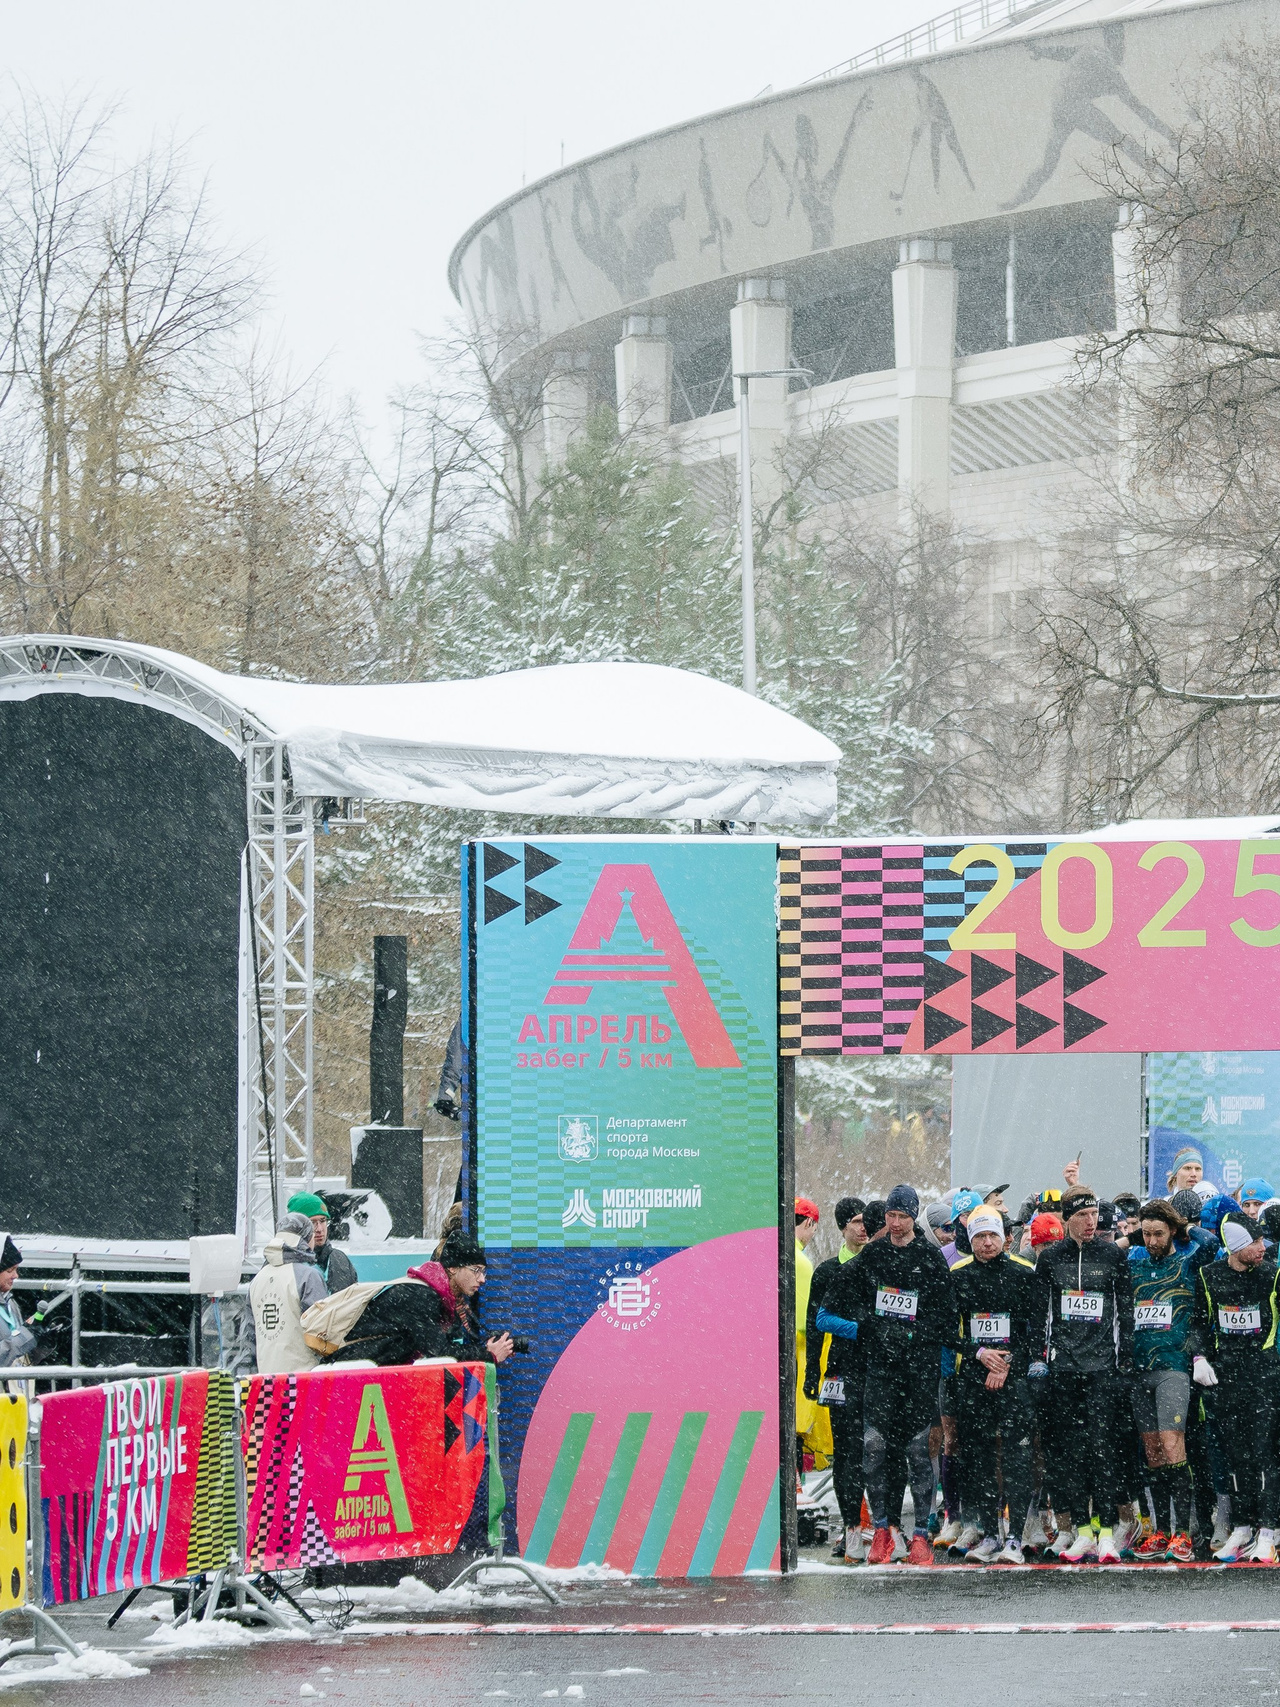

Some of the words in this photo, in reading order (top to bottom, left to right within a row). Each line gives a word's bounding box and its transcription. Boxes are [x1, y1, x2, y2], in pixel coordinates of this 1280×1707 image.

[517, 1014, 672, 1044] АПРЕЛЬ
[516, 1048, 590, 1068] забег
[618, 1048, 632, 1068] 5
[640, 1053, 672, 1068] км
[606, 1117, 687, 1130] Департамент
[607, 1133, 648, 1145] спорта
[607, 1148, 648, 1160] города
[653, 1147, 700, 1157] Москвы
[602, 1185, 702, 1208] МОСКОВСКИЙ
[602, 1209, 649, 1228] СПОРТ
[599, 1262, 659, 1285] БЕГОВОЕ
[881, 1294, 912, 1309] 4793
[1067, 1298, 1098, 1310] 1458
[597, 1303, 661, 1331] СООБЩЕСТВО
[1137, 1307, 1167, 1319] 6724
[1224, 1312, 1253, 1323] 1661
[978, 1320, 999, 1332] 781
[102, 1378, 162, 1433] ТВОИ
[106, 1426, 187, 1488] ПЕРВЫЕ
[106, 1492, 118, 1542] 5
[126, 1484, 157, 1537] КМ
[334, 1495, 390, 1521] АПРЕЛЬ
[334, 1523, 361, 1539] забег
[369, 1520, 376, 1536] 5
[377, 1521, 390, 1535] км
